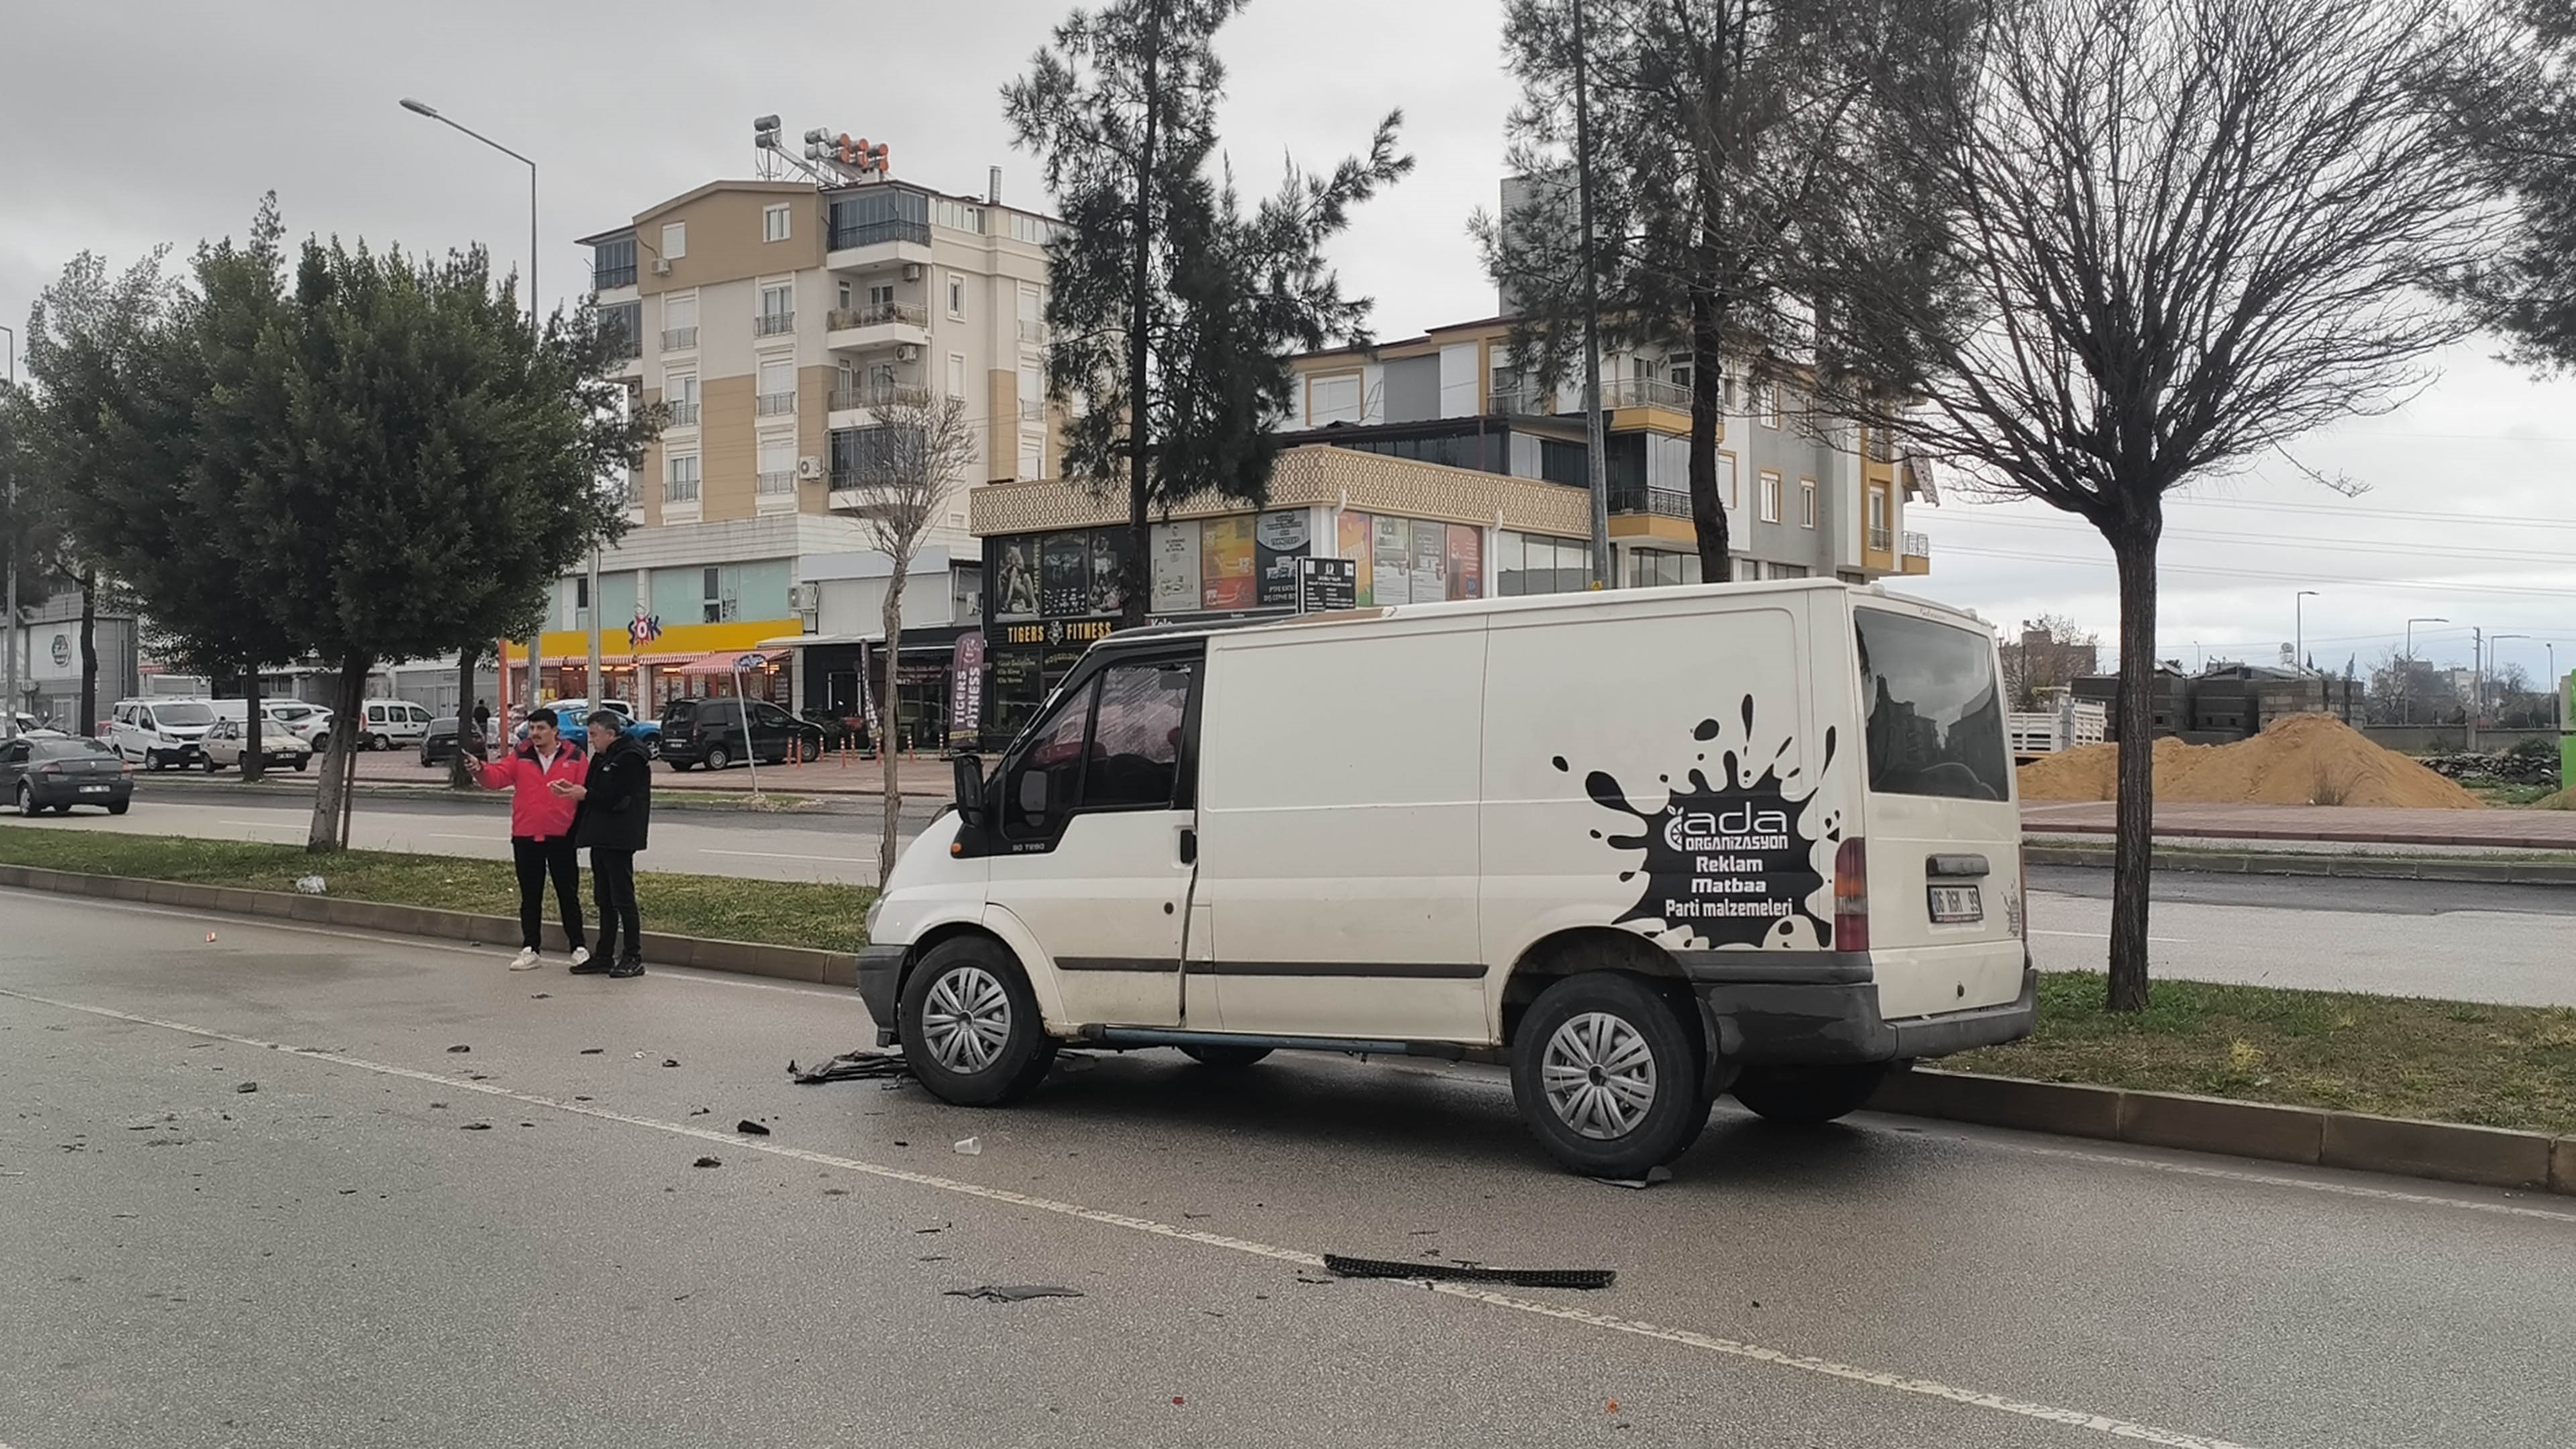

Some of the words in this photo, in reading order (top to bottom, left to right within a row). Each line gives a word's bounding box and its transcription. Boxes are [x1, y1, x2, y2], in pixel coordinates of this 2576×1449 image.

[1008, 626, 1044, 643] TIGERS
[1067, 622, 1112, 640] FITNESS
[955, 670, 967, 725] TIGERS
[1683, 801, 1787, 835] ada
[1696, 855, 1763, 873] Reklam
[1691, 877, 1766, 893] Matbaa
[1665, 898, 1699, 917] Parti
[1703, 898, 1793, 917] malzemeleri
